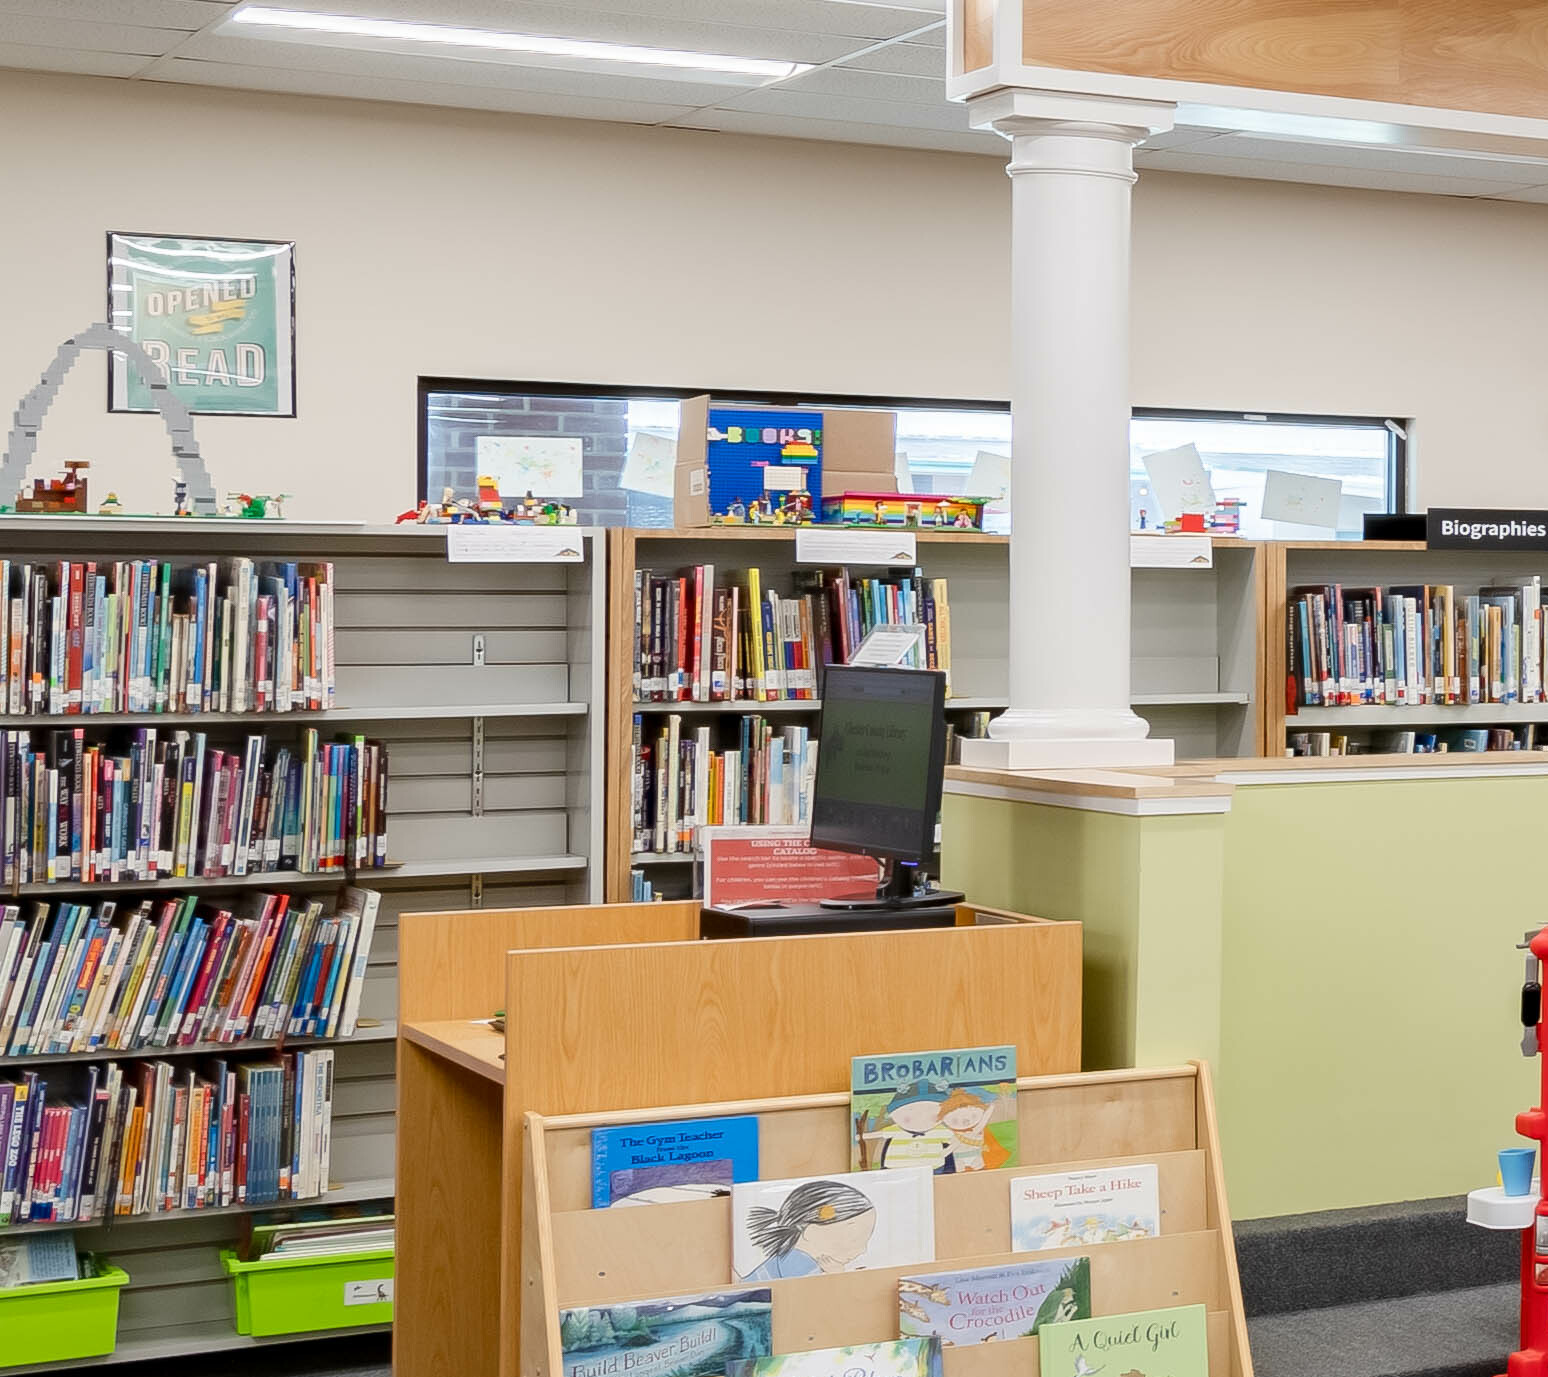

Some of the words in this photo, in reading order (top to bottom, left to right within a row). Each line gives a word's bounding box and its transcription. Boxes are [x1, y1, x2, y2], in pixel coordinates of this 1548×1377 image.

[148, 276, 257, 316] OPENED
[141, 340, 266, 387] READ
[1442, 519, 1546, 541] Biographies
[773, 847, 817, 855] CATALOG
[11, 1125, 23, 1148] LEGO
[620, 1137, 645, 1148] The
[646, 1135, 676, 1147] Gym
[679, 1131, 725, 1142] Teacher
[8, 1149, 20, 1167] ZOO
[631, 1153, 665, 1165] Black
[669, 1150, 714, 1162] Lagoon
[1023, 1186, 1062, 1202] Sheep
[1065, 1182, 1095, 1196] Take
[1098, 1184, 1107, 1193] a
[1110, 1177, 1143, 1191] Hike
[957, 1286, 1010, 1306] Watch
[1012, 1282, 1047, 1300] Out
[949, 1303, 1035, 1331] Crocodile
[971, 1305, 986, 1316] for
[987, 1304, 1004, 1315] the
[1070, 1332, 1088, 1353] A
[1146, 1320, 1181, 1352] Girl
[624, 1342, 676, 1372] Beaver
[679, 1327, 718, 1354] Build!
